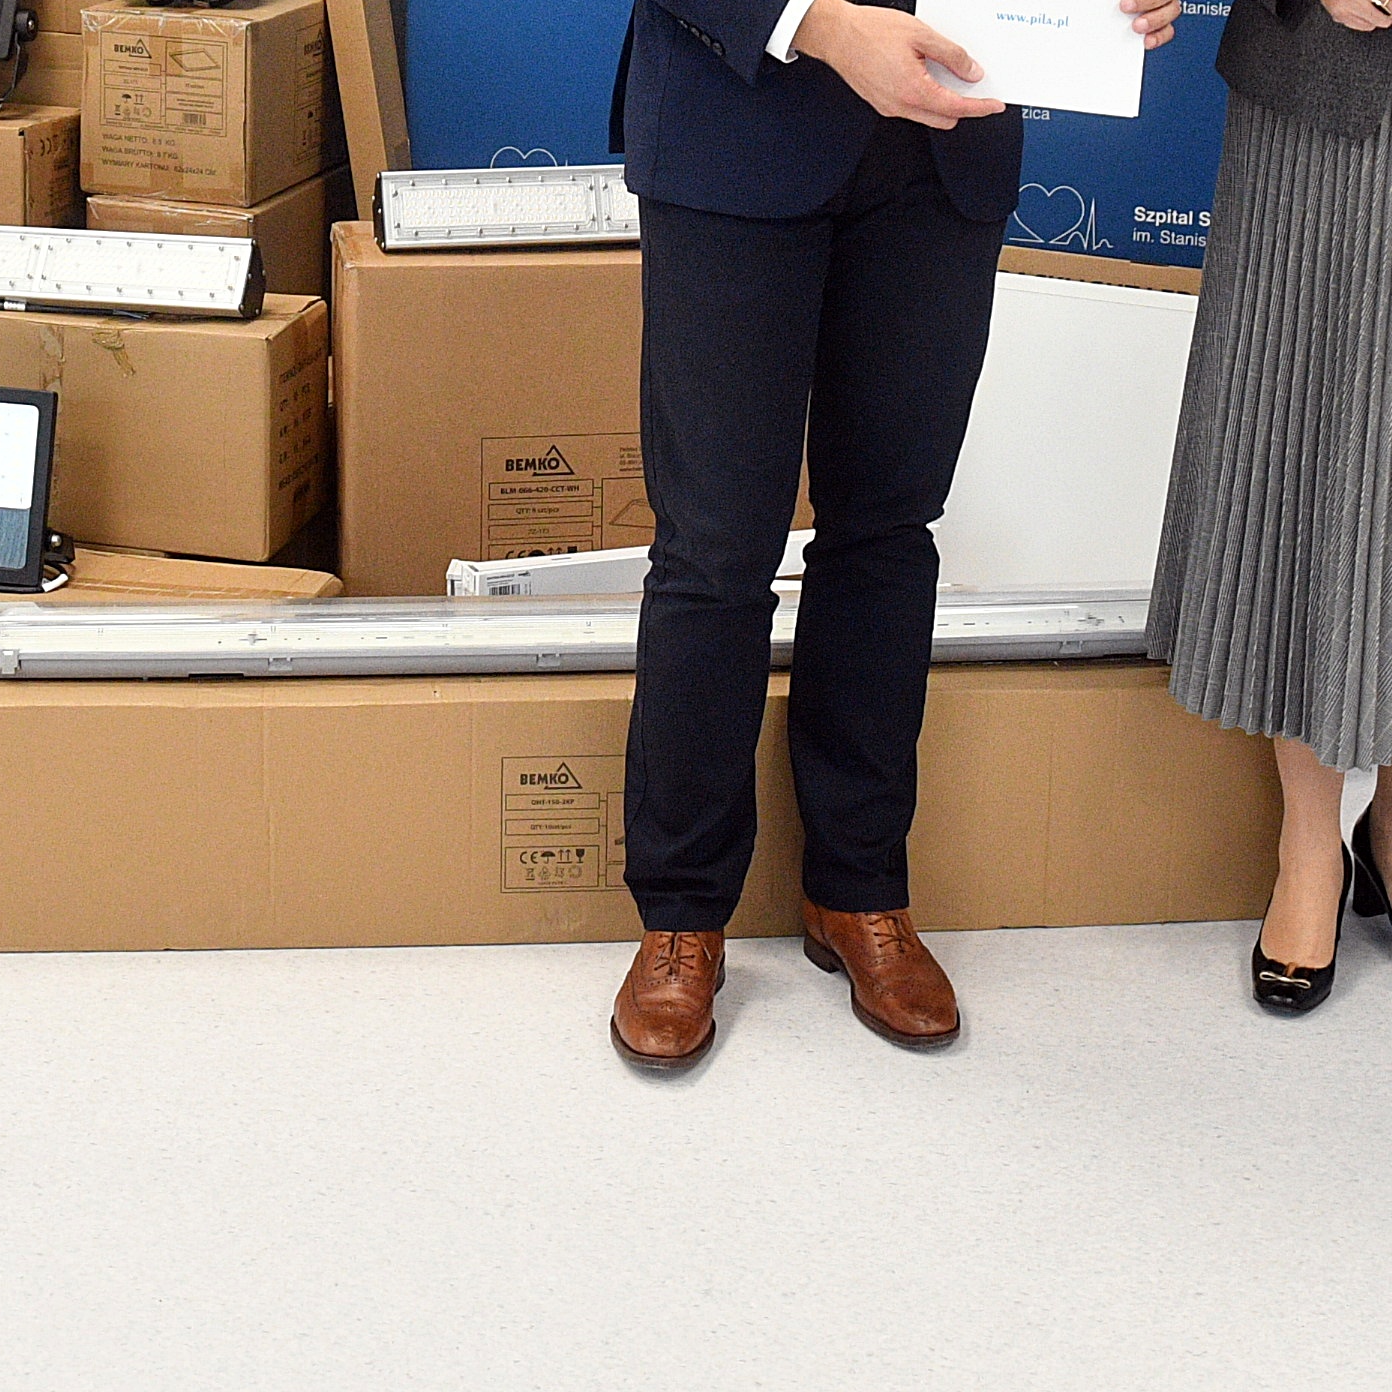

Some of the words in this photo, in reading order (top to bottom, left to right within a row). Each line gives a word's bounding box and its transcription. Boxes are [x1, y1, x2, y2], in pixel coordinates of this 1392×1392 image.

[113, 43, 145, 56] BEMKO
[1133, 206, 1194, 227] Szpital
[504, 457, 561, 473] BEMKO
[519, 773, 569, 786] BEMKO
